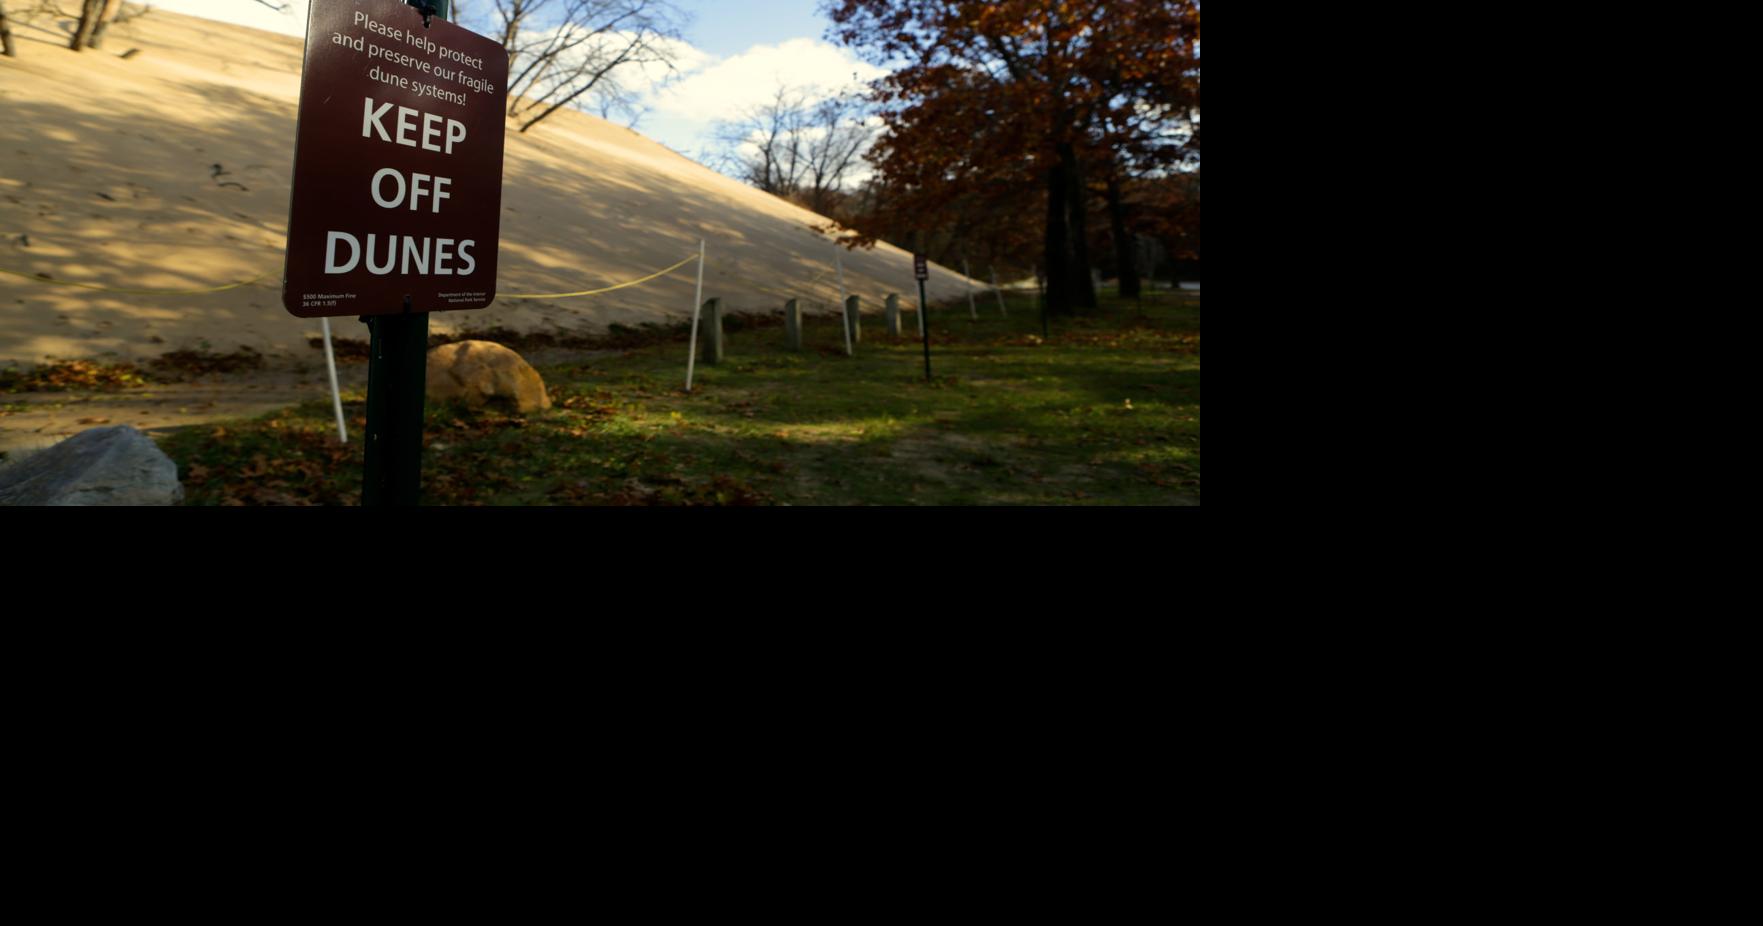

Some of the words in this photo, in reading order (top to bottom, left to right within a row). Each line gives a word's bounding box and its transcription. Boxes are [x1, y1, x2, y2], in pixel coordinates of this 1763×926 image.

[331, 31, 364, 52] and
[368, 43, 431, 73] preserve
[434, 65, 456, 81] our
[457, 70, 494, 95] fragile
[354, 11, 403, 41] Please
[406, 29, 436, 55] help
[439, 46, 483, 71] protect
[369, 65, 408, 89] dune
[411, 80, 467, 106] systems!
[362, 97, 467, 154] KEEP
[371, 167, 452, 213] OFF
[324, 230, 476, 276] DUNES
